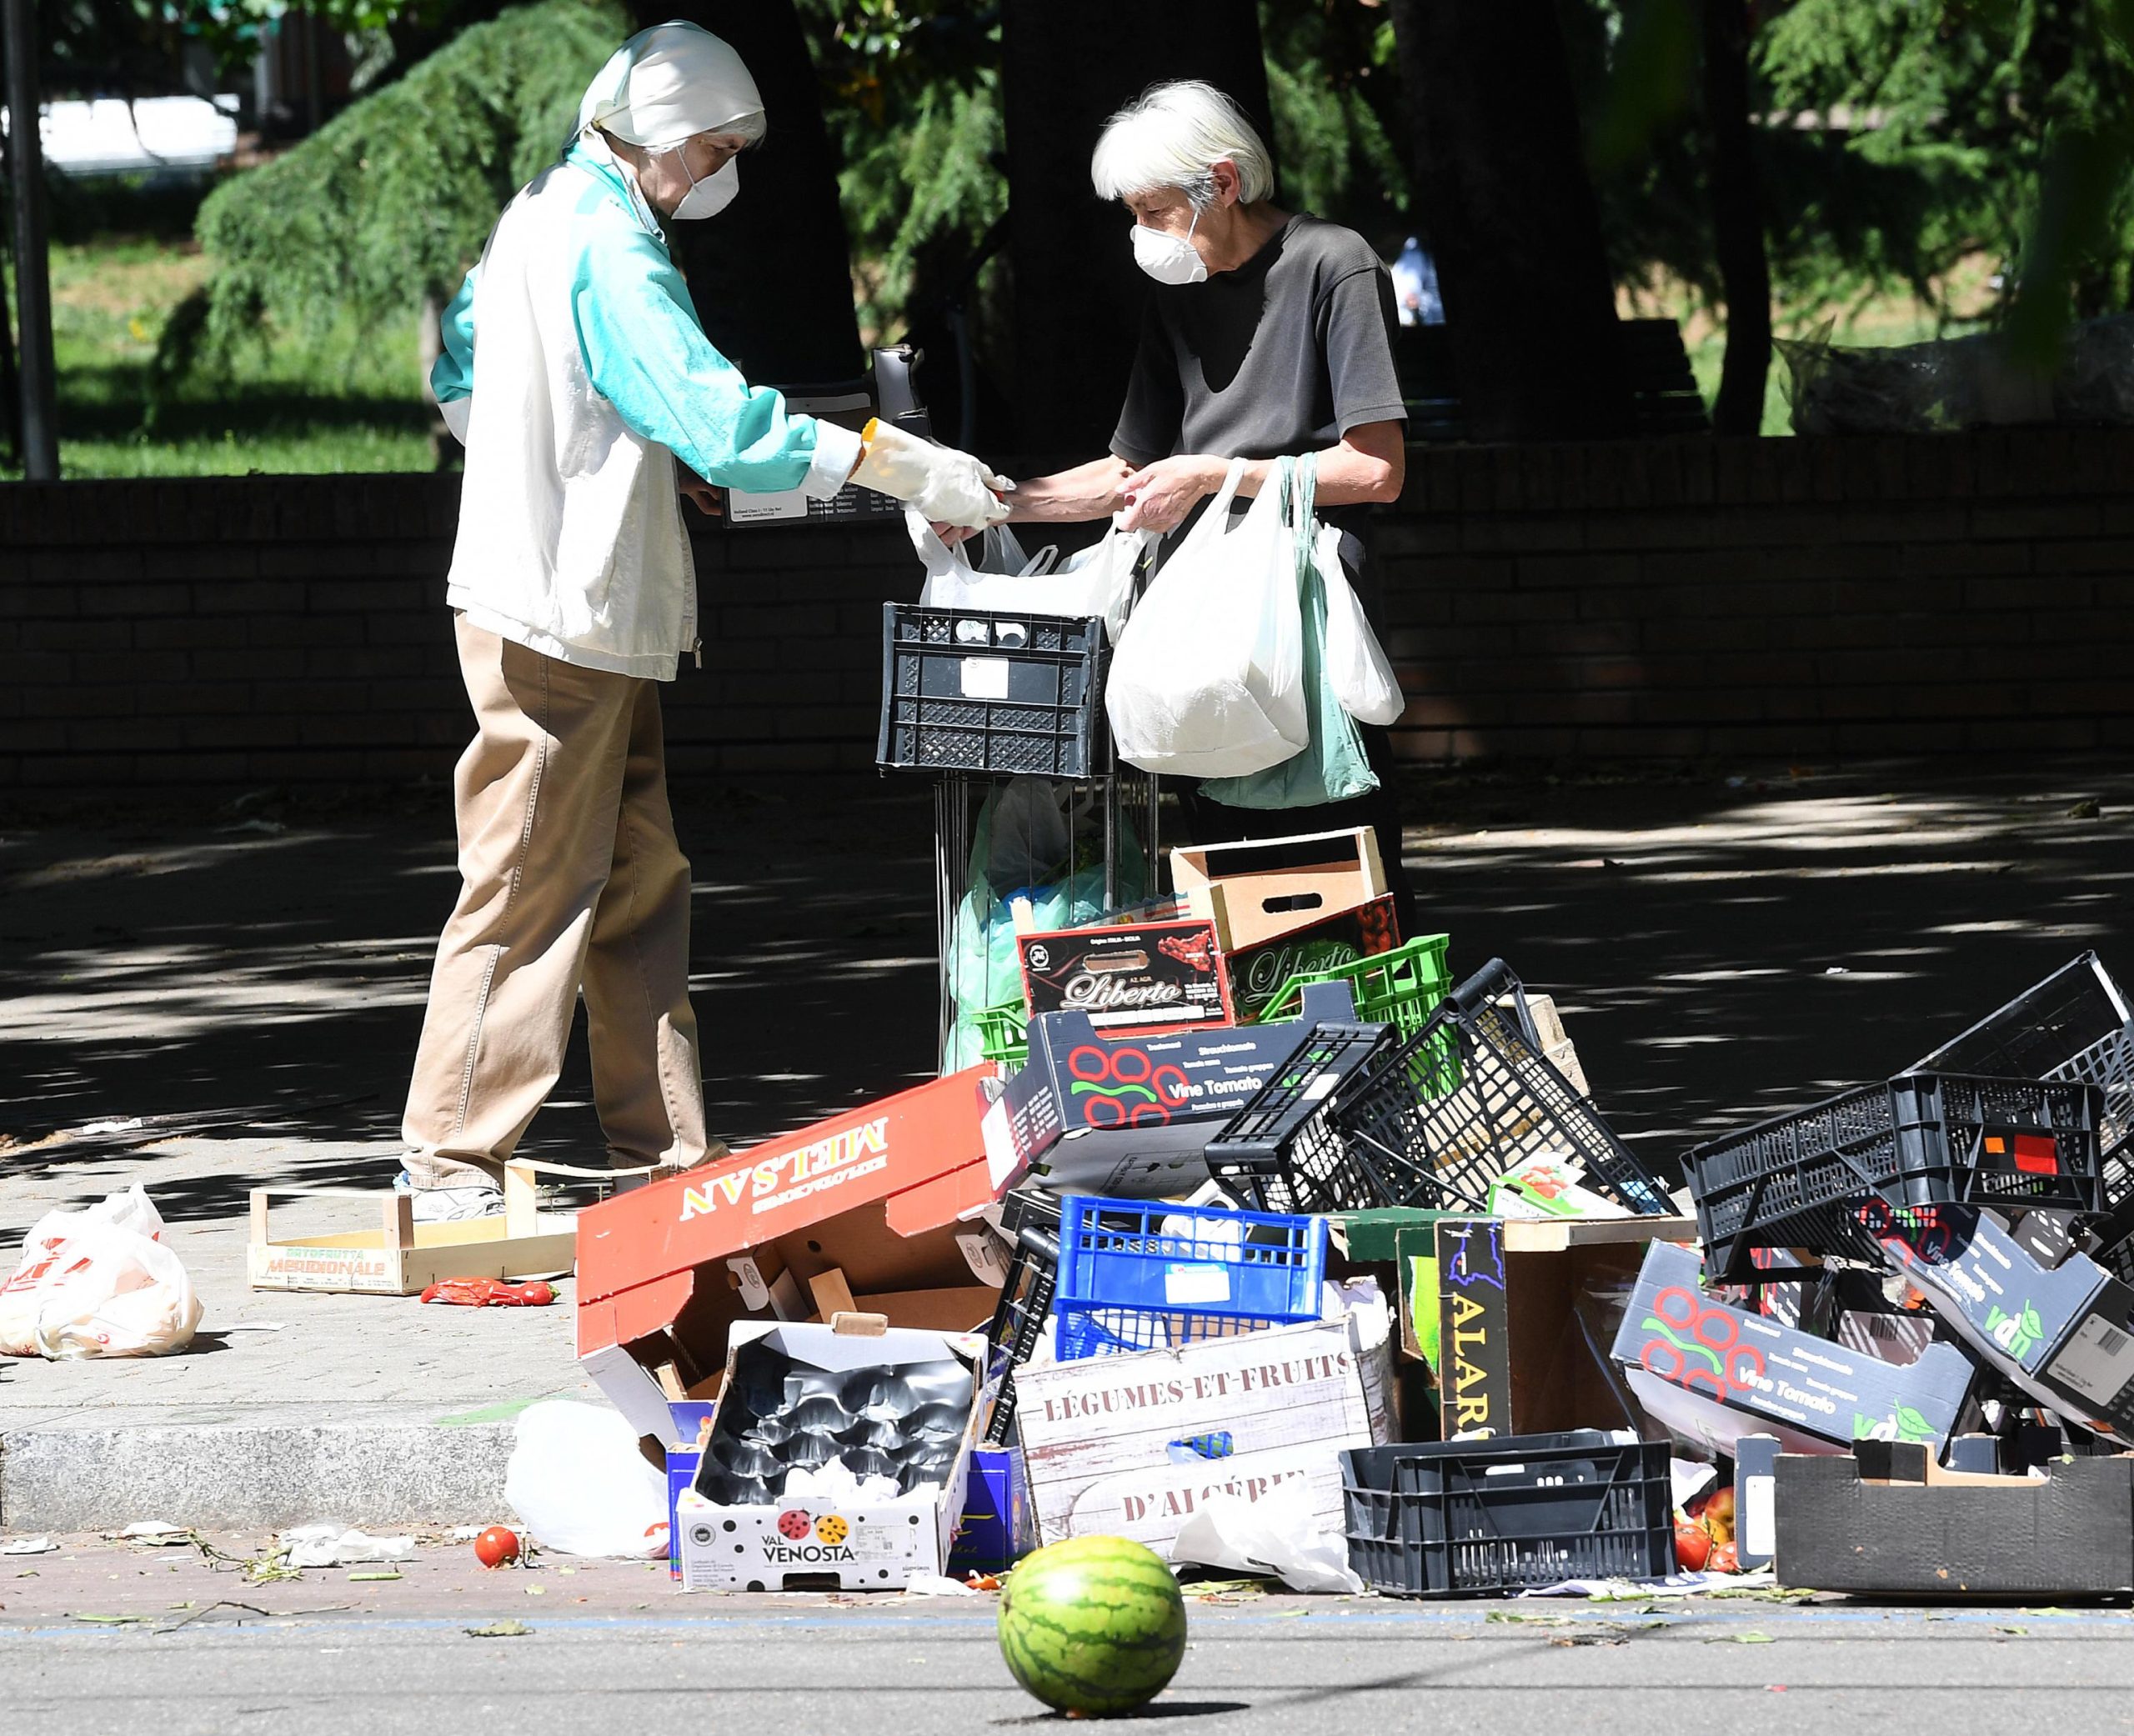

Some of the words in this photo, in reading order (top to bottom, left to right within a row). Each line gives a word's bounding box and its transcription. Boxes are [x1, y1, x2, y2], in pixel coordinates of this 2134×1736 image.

[1060, 974, 1182, 1009] Liberto
[1169, 1083, 1204, 1098] Vine
[1204, 1076, 1263, 1095] Tomato
[1453, 1292, 1490, 1440] ALAR
[1740, 1367, 1774, 1393] Vine
[1777, 1380, 1836, 1415] Tomato
[762, 1535, 784, 1546] VAL
[763, 1546, 855, 1563] VENOSTA
